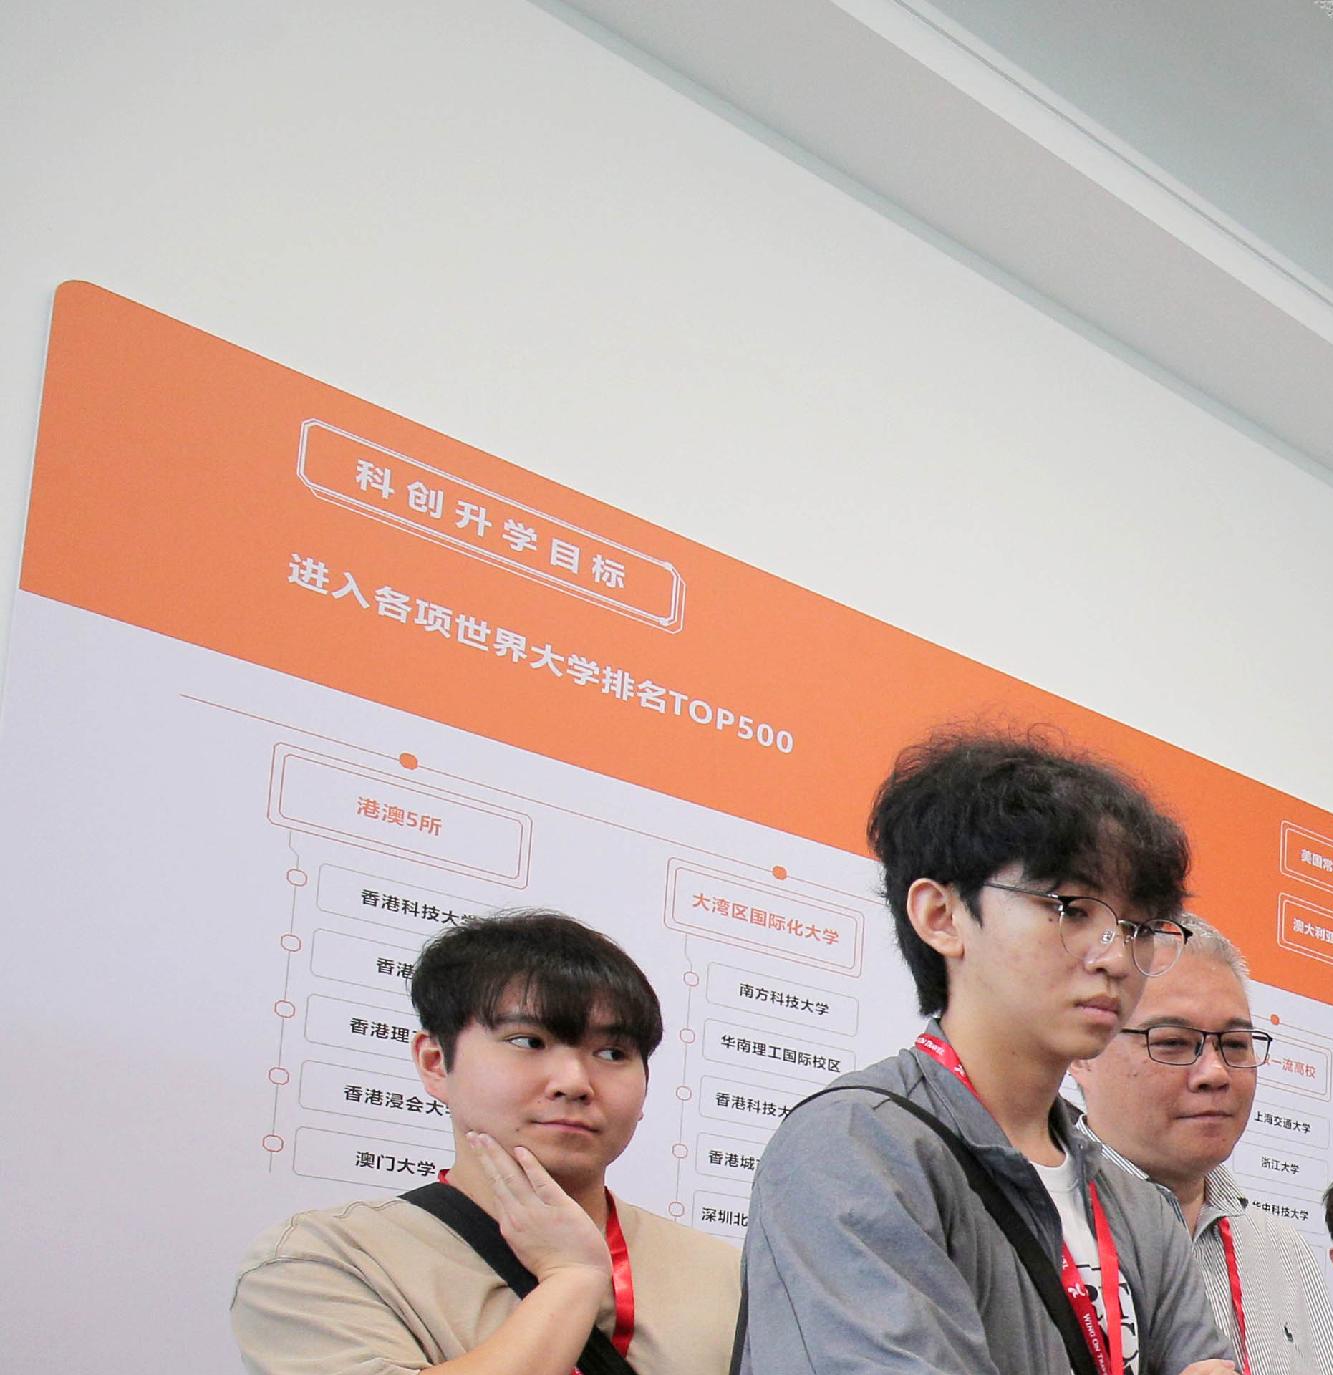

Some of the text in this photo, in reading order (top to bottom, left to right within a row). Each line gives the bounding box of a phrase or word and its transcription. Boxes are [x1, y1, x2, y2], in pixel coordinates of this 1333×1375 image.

[356, 458, 626, 590] 科创升学目标
[287, 553, 794, 755] 进入各项世界大学排名TOP500
[355, 796, 442, 837] 港澳5所
[692, 892, 840, 946] 大湾区国际化大学
[738, 982, 830, 1016] 南方科技大学
[350, 1017, 418, 1044] 香港理
[719, 1035, 842, 1074] 华南理工国际校区
[1254, 1110, 1311, 1135] 上海交通大学
[355, 1150, 436, 1177] 澳门大学
[708, 1150, 761, 1171] 香港城
[1261, 1156, 1301, 1175] 浙江大学
[701, 1206, 749, 1227] 深圳北
[1081, 1312, 1097, 1337] WING
[1091, 1337, 1102, 1352] ON
